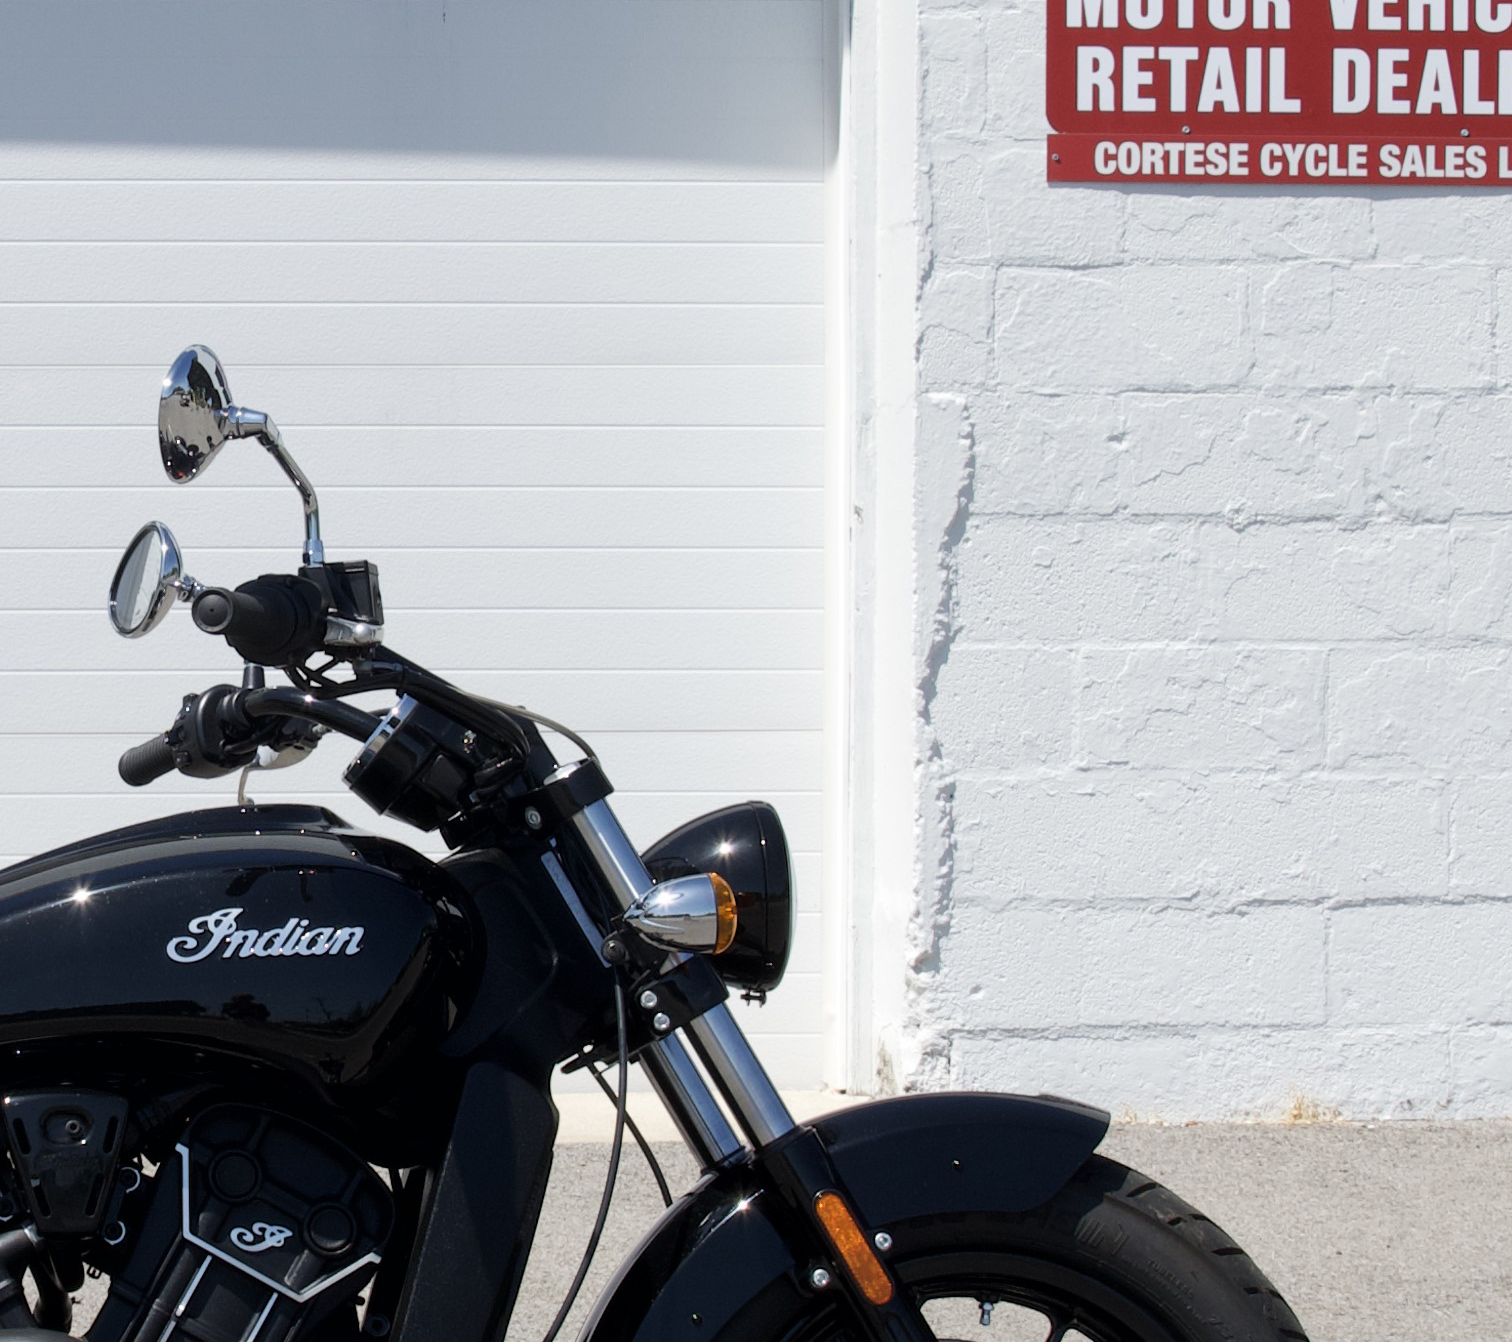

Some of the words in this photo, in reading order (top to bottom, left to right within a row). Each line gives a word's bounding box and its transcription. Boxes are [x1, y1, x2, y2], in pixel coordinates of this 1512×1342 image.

[1076, 45, 1302, 114] RETAIL
[1094, 140, 1249, 177] CORTESE
[1260, 143, 1368, 177] CYCLE
[1378, 144, 1487, 179] SALES
[166, 908, 365, 963] Indian
